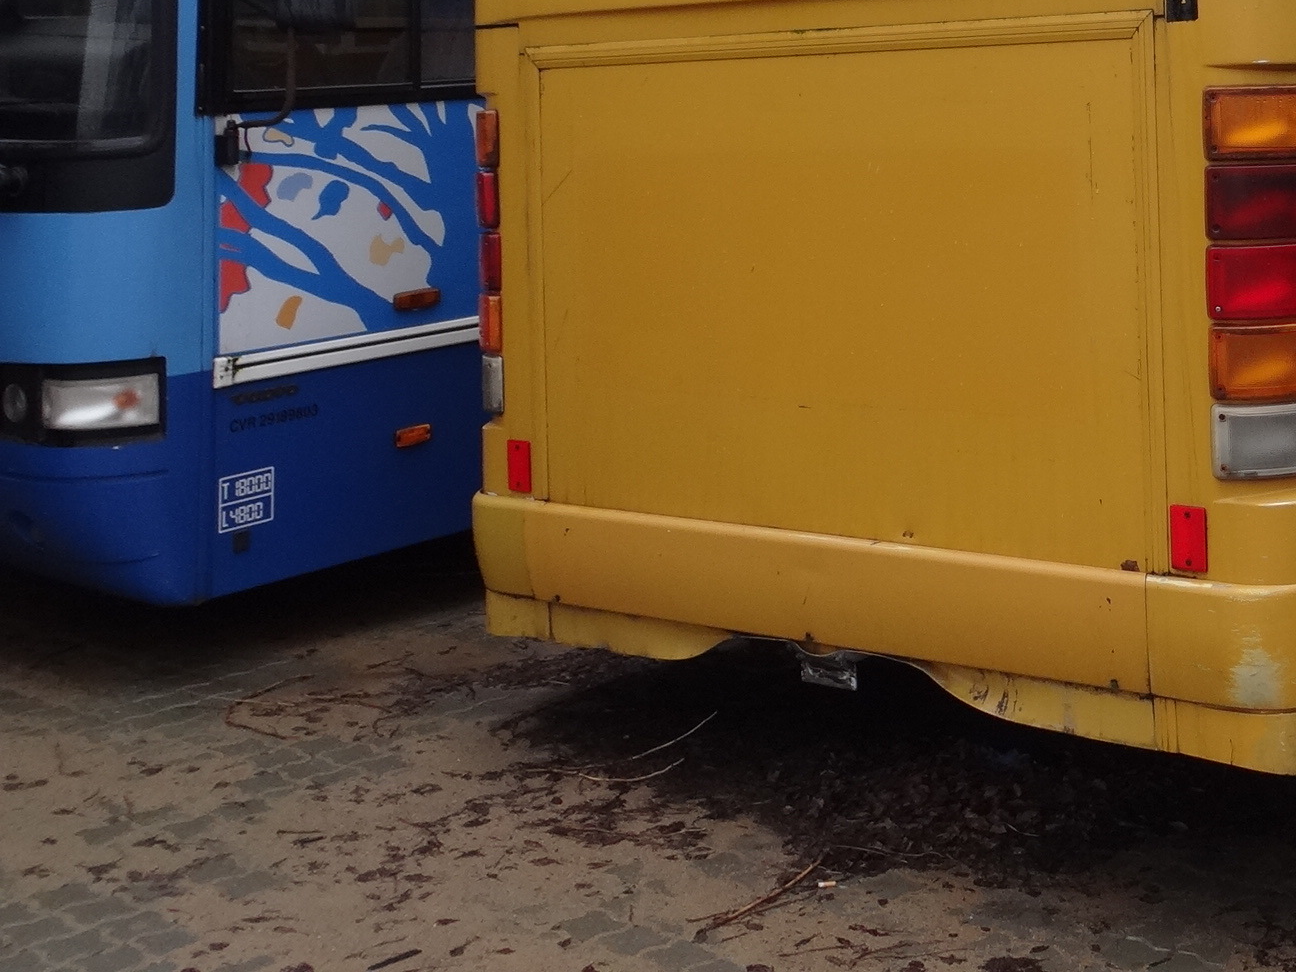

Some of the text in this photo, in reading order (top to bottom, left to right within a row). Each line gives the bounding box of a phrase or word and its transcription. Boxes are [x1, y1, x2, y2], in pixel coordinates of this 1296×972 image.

[221, 473, 271, 500] T 18000
[222, 502, 263, 527] L 4800
